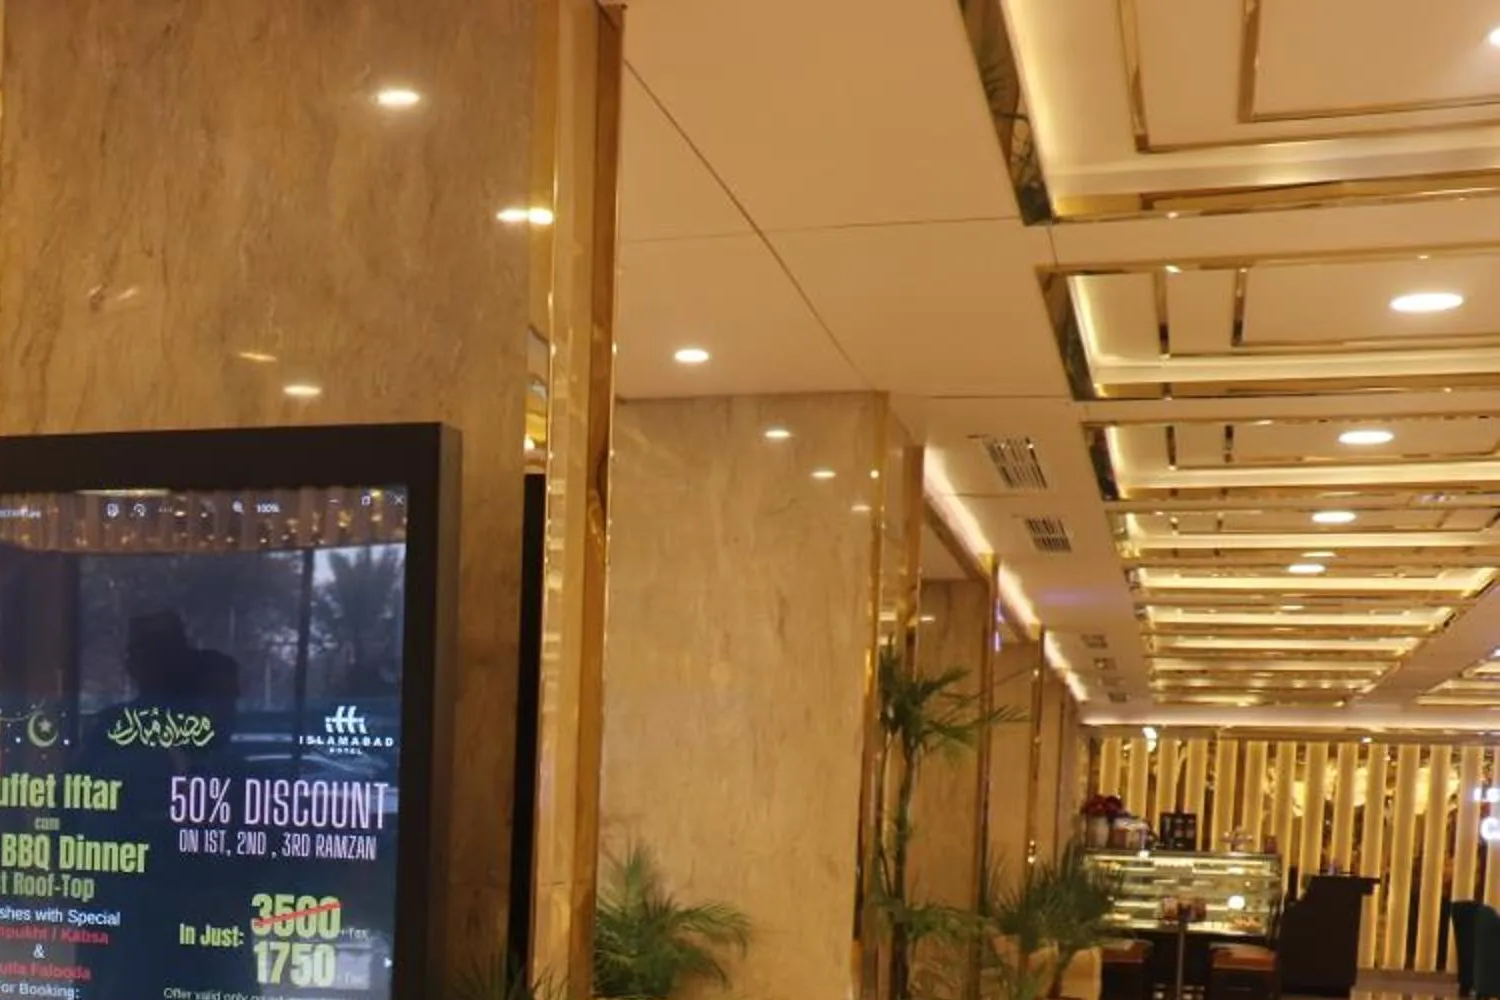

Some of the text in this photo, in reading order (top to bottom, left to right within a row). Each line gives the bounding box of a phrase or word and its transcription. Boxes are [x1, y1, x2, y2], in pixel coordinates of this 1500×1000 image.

[299, 735, 394, 747] ISLAMABAD
[64, 773, 123, 810] Iftar
[170, 776, 389, 830] 50% DISCOUNT
[1, 833, 51, 871] BBQ
[58, 834, 150, 873] Dinner
[179, 829, 199, 853] ON
[237, 831, 267, 856] 2ND
[282, 832, 311, 858] 3RD
[315, 833, 377, 862] RAMZAN
[13, 871, 96, 902] Roof-Top
[35, 908, 63, 922] with
[67, 909, 122, 927] Special
[251, 893, 341, 940] 3500
[33, 944, 45, 959] &
[179, 923, 245, 948] In Just:
[253, 940, 336, 989] 1750
[19, 982, 82, 1000] Booking:
